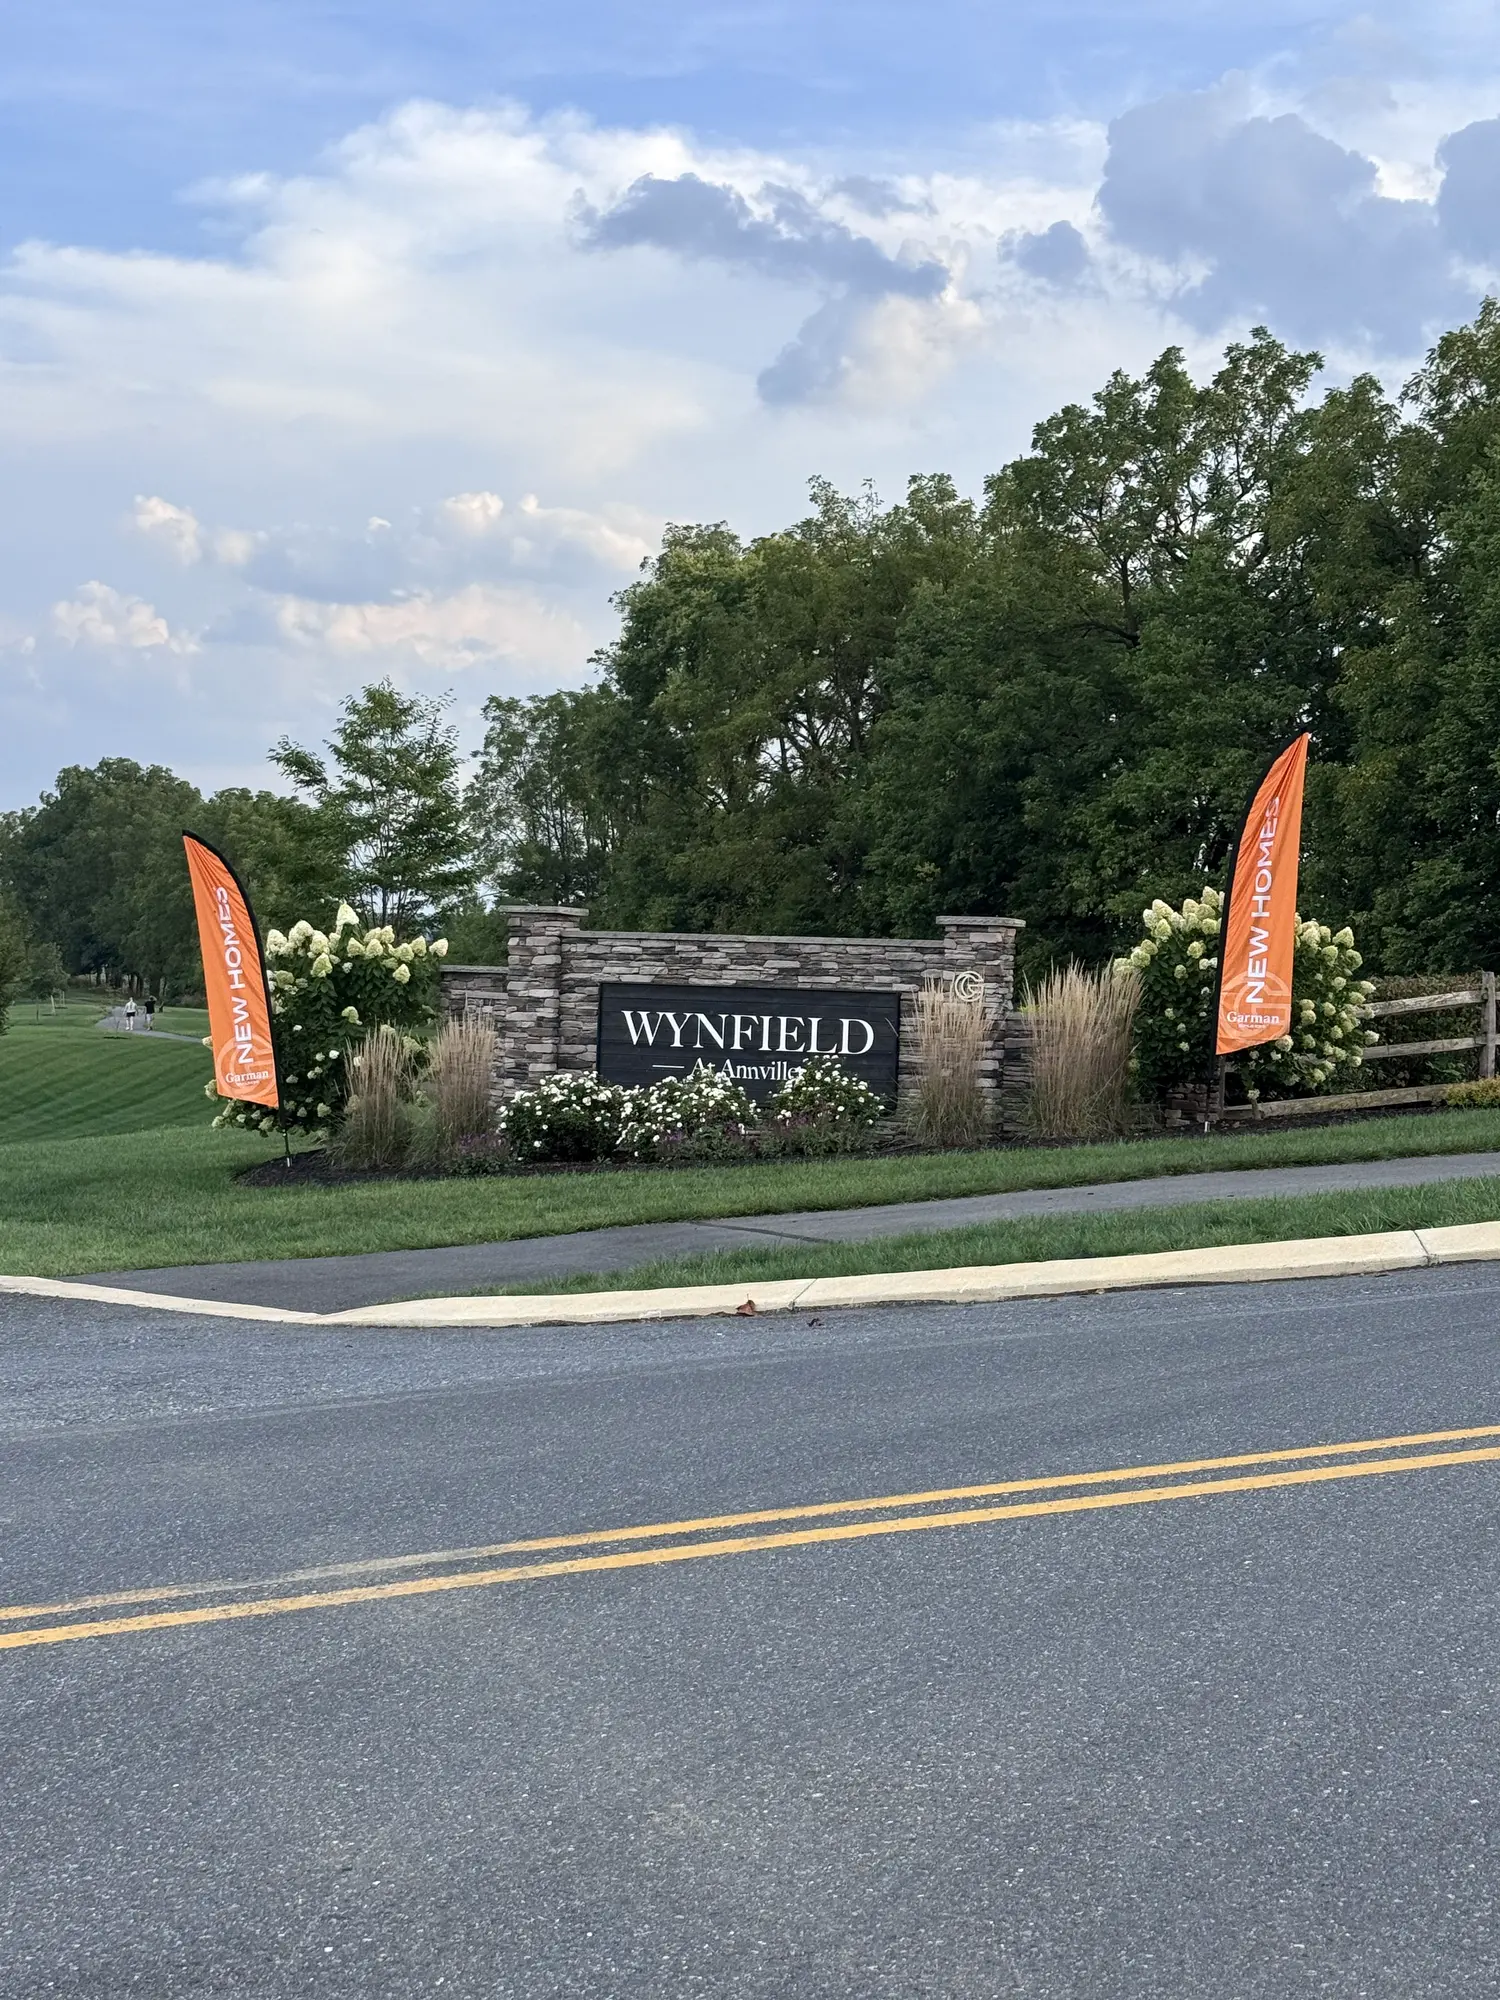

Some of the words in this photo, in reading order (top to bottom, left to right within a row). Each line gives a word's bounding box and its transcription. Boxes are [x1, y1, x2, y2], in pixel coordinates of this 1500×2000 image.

[1251, 797, 1279, 917] HOMES
[217, 886, 246, 989] HOMES
[1246, 927, 1271, 1003] NEW
[232, 997, 253, 1064] NEW
[621, 1009, 875, 1055] WYNFIELD
[1226, 1011, 1280, 1024] Garman
[225, 1071, 269, 1083] Garman
